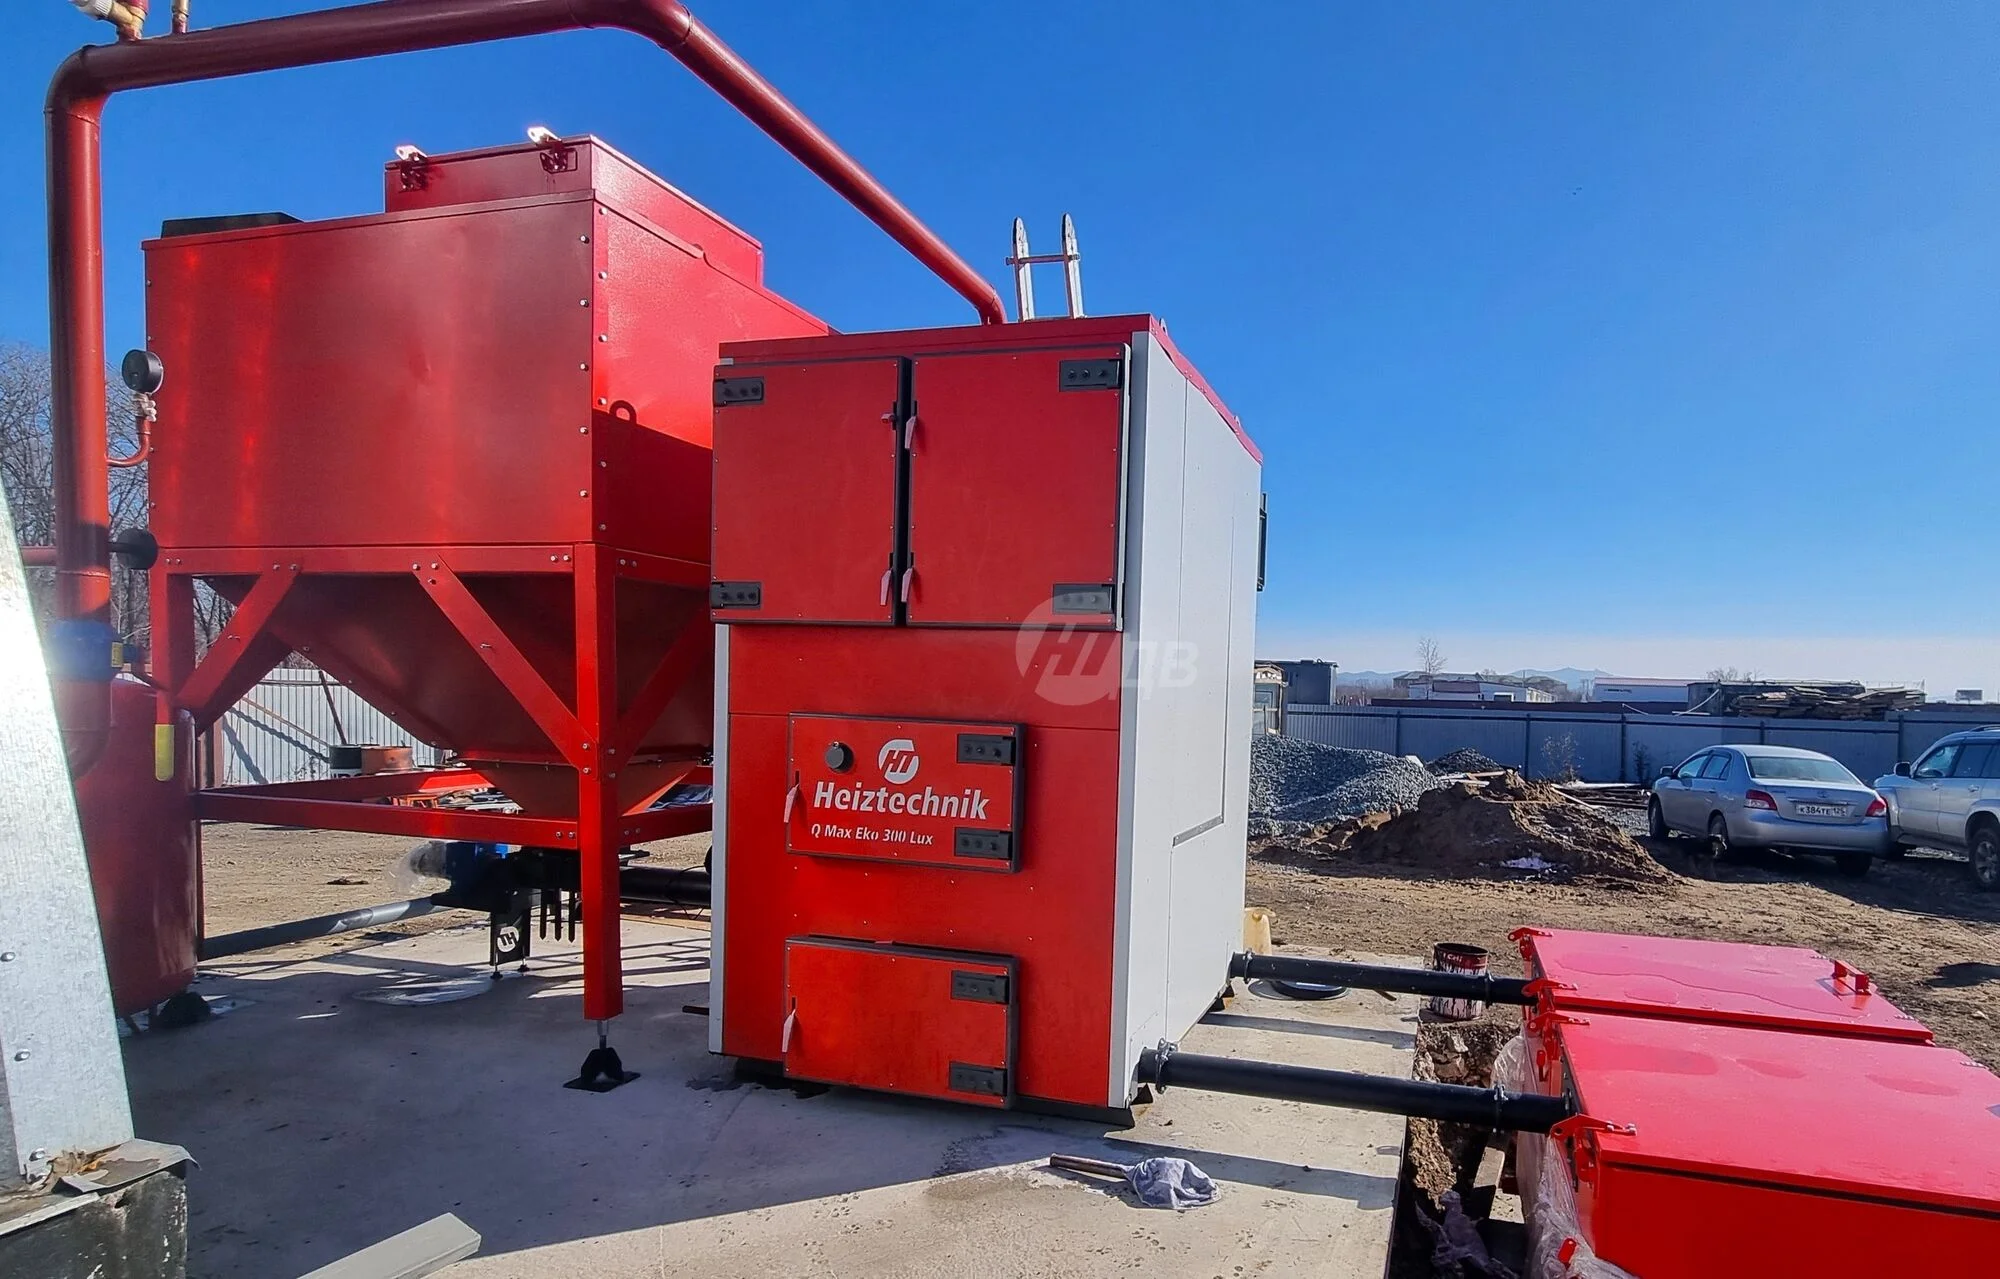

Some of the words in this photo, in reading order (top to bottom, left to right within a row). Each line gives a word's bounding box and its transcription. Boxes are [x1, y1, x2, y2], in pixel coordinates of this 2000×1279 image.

[813, 781, 990, 820] Heiztechnik
[811, 823, 821, 838] Q
[824, 824, 852, 839] Max
[855, 826, 879, 841] Eko
[883, 828, 906, 843] 300
[910, 830, 934, 845] Lux
